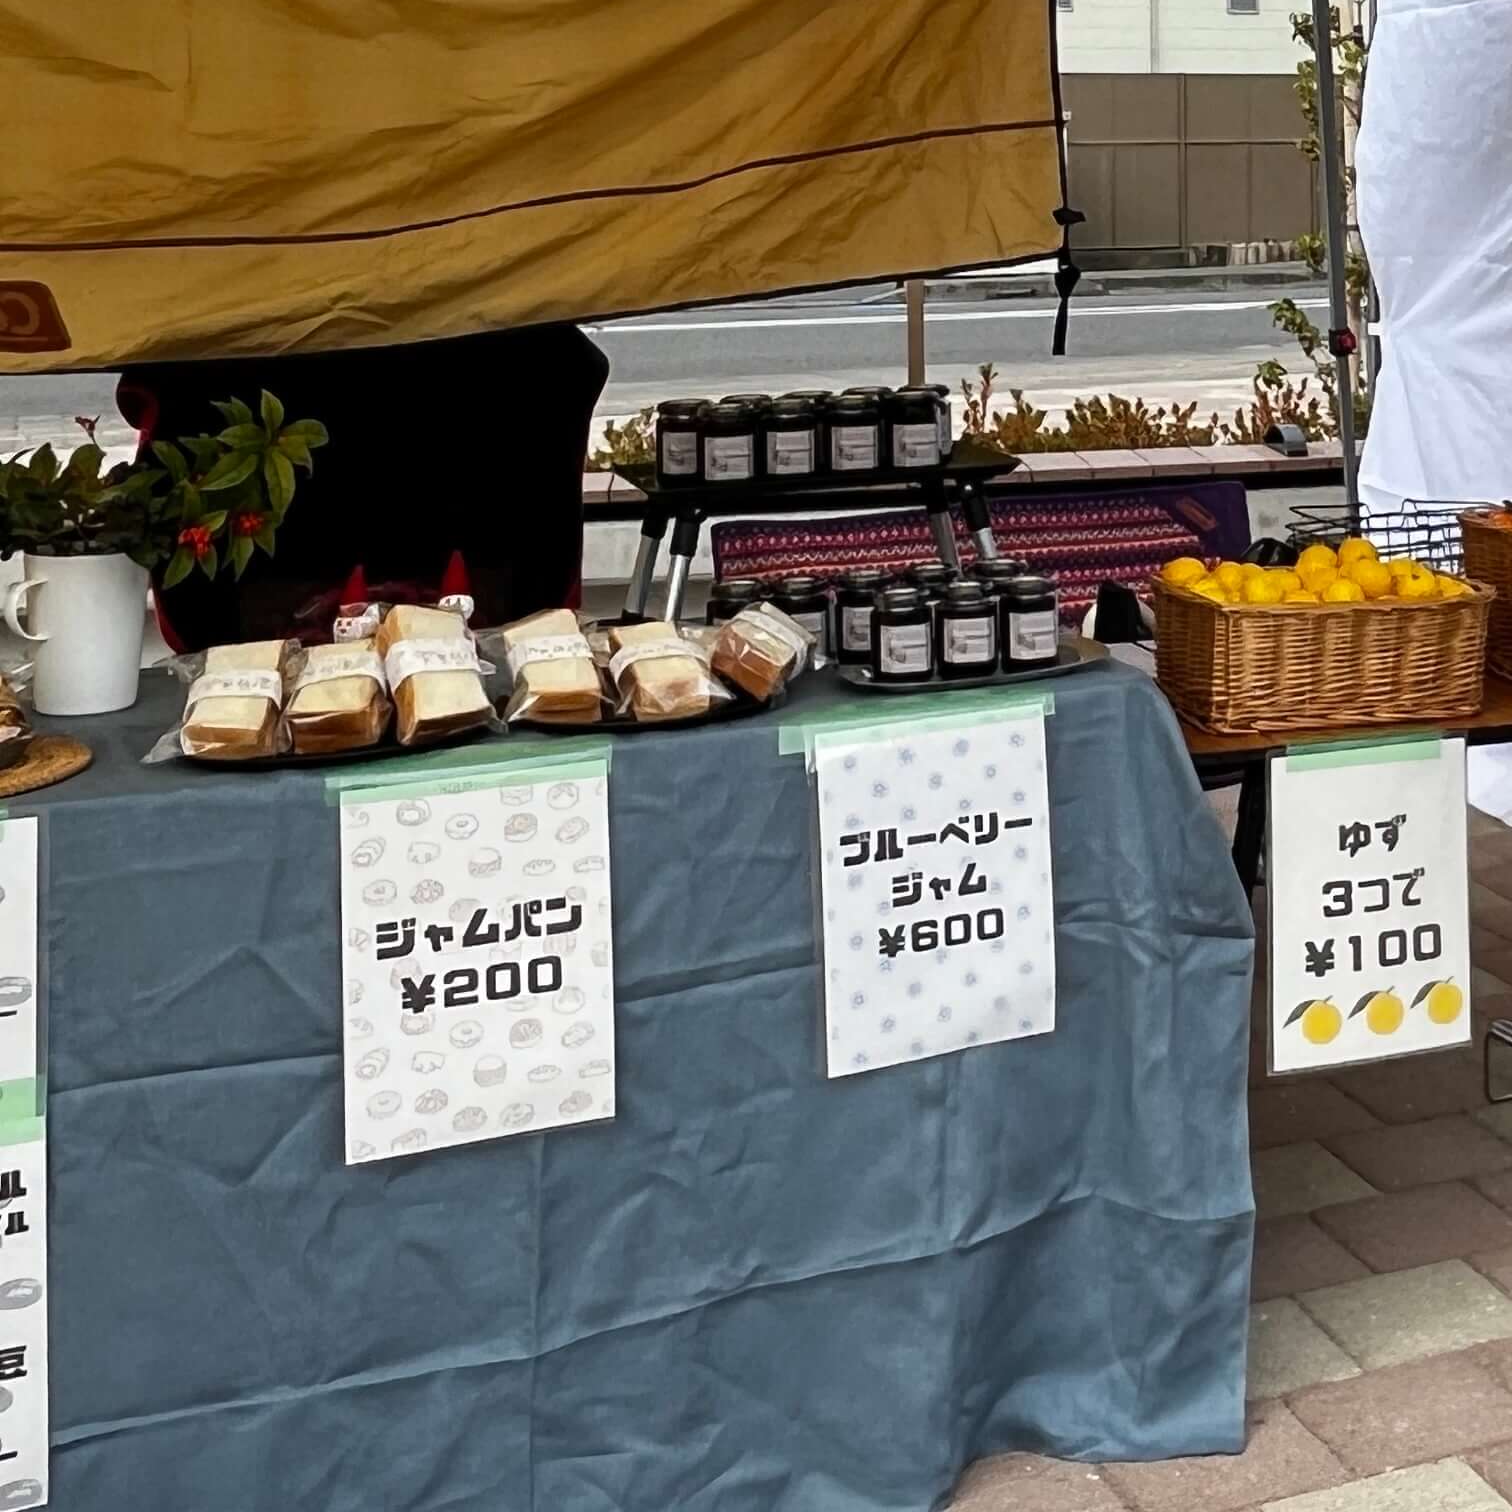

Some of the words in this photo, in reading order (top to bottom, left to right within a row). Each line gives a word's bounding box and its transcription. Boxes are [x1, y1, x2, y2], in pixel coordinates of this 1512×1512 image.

[839, 812, 1033, 867] ブルーベリー
[1338, 813, 1407, 858] ゆず
[892, 863, 988, 907] ジャム
[375, 896, 583, 960] ジャムパン
[878, 907, 1005, 958] ¥600
[1304, 923, 1442, 978] ¥100
[399, 954, 563, 1015] ¥200
